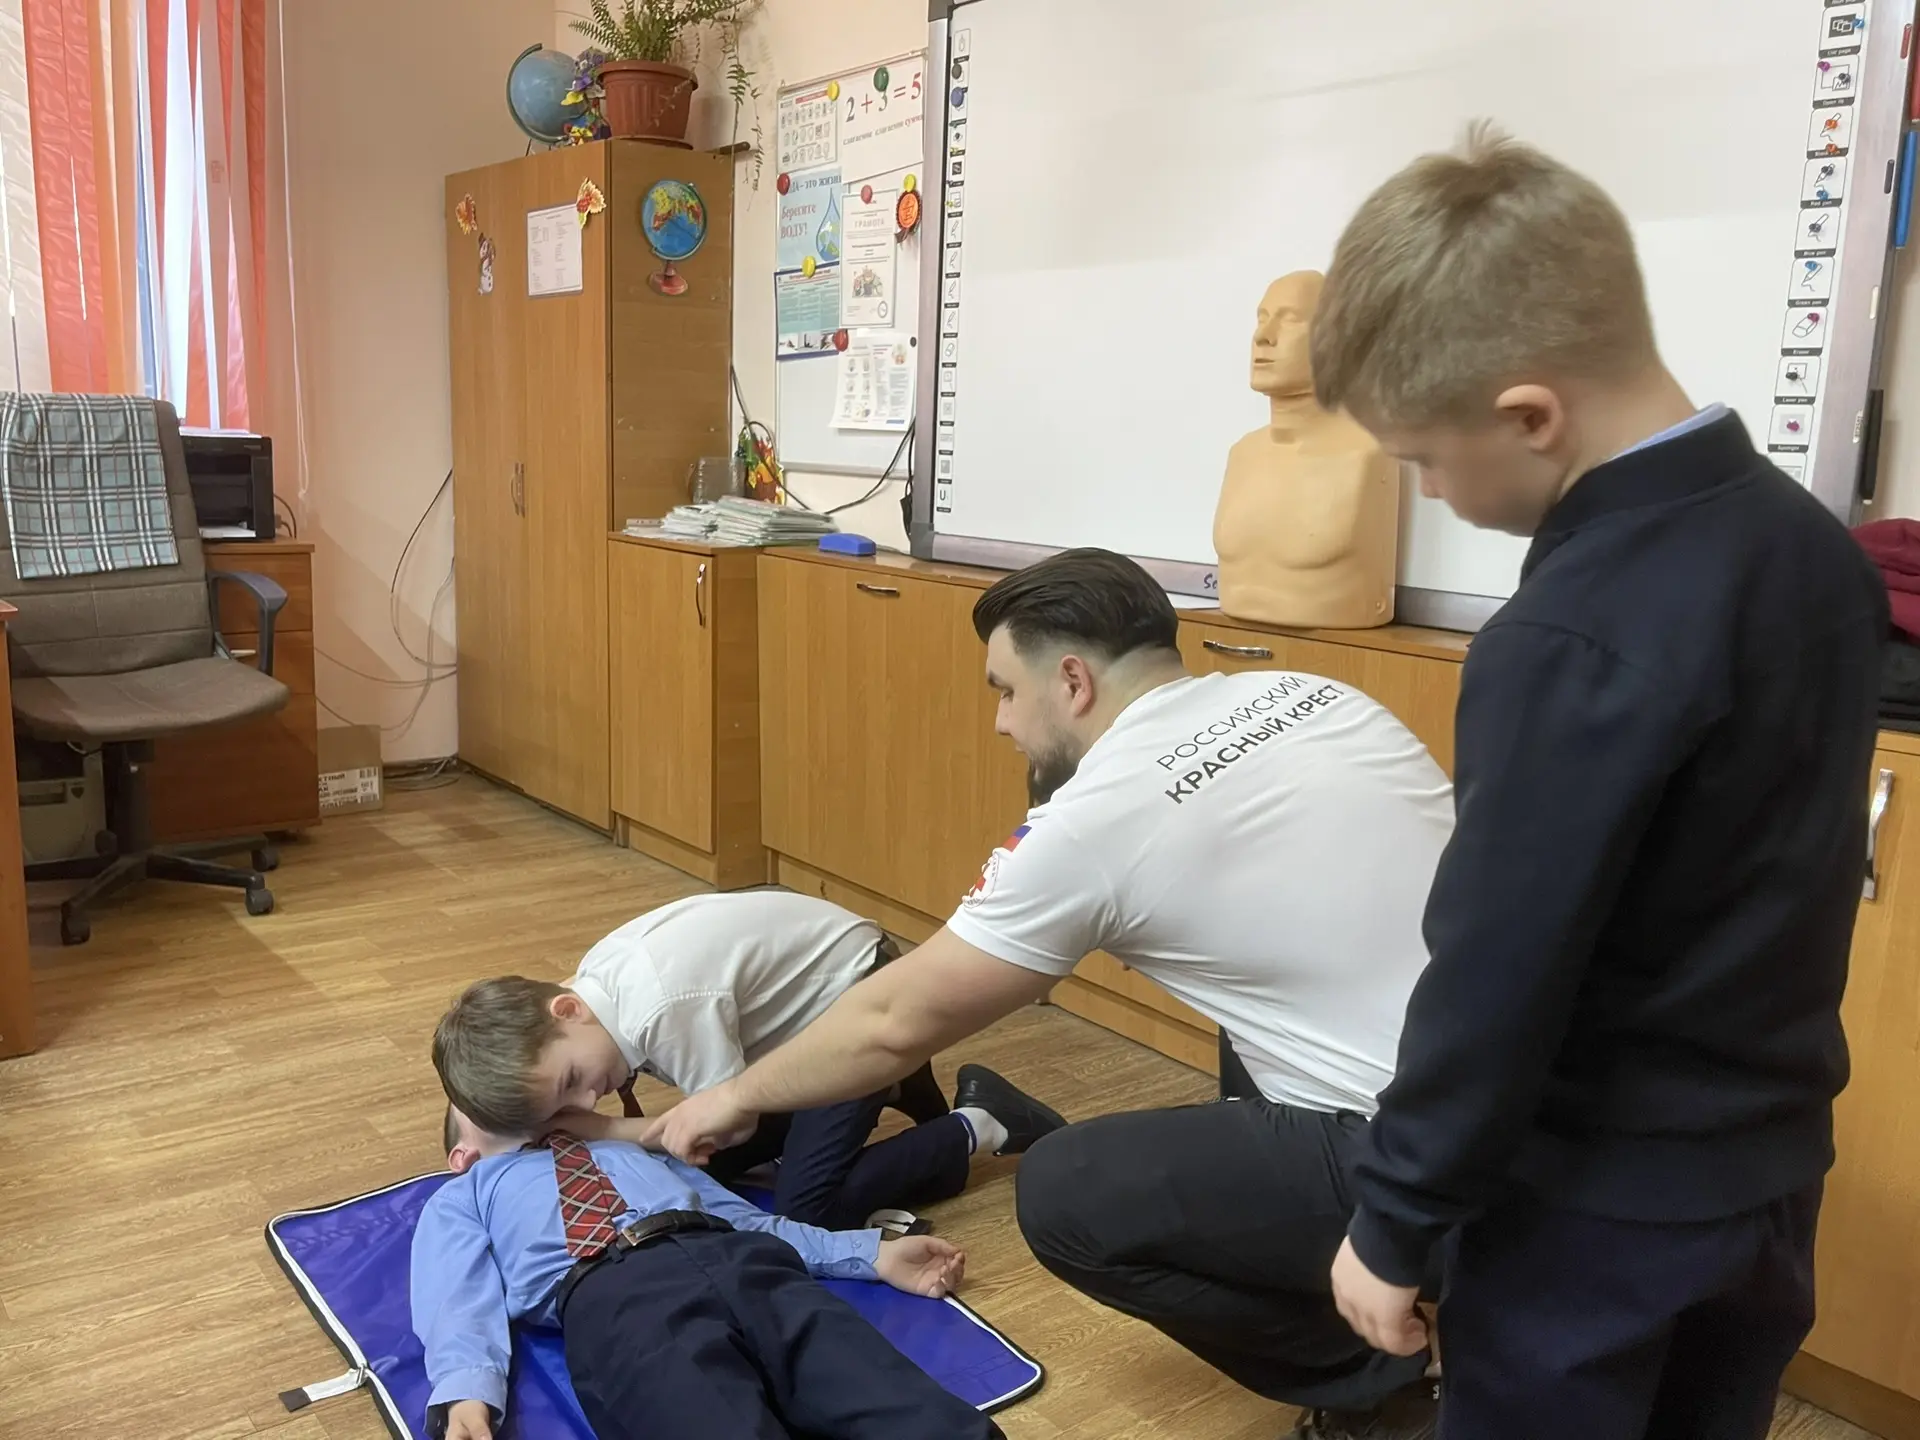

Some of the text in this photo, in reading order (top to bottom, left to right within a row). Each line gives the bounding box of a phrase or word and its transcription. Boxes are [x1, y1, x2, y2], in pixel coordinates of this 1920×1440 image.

[846, 96, 855, 123] 2
[911, 72, 921, 100] 5
[854, 218, 885, 229] ГРАМОТА
[1156, 675, 1308, 771] РОССИЙСКИЙ
[1164, 683, 1345, 805] КРАСНЫЙ КРЕСТ
